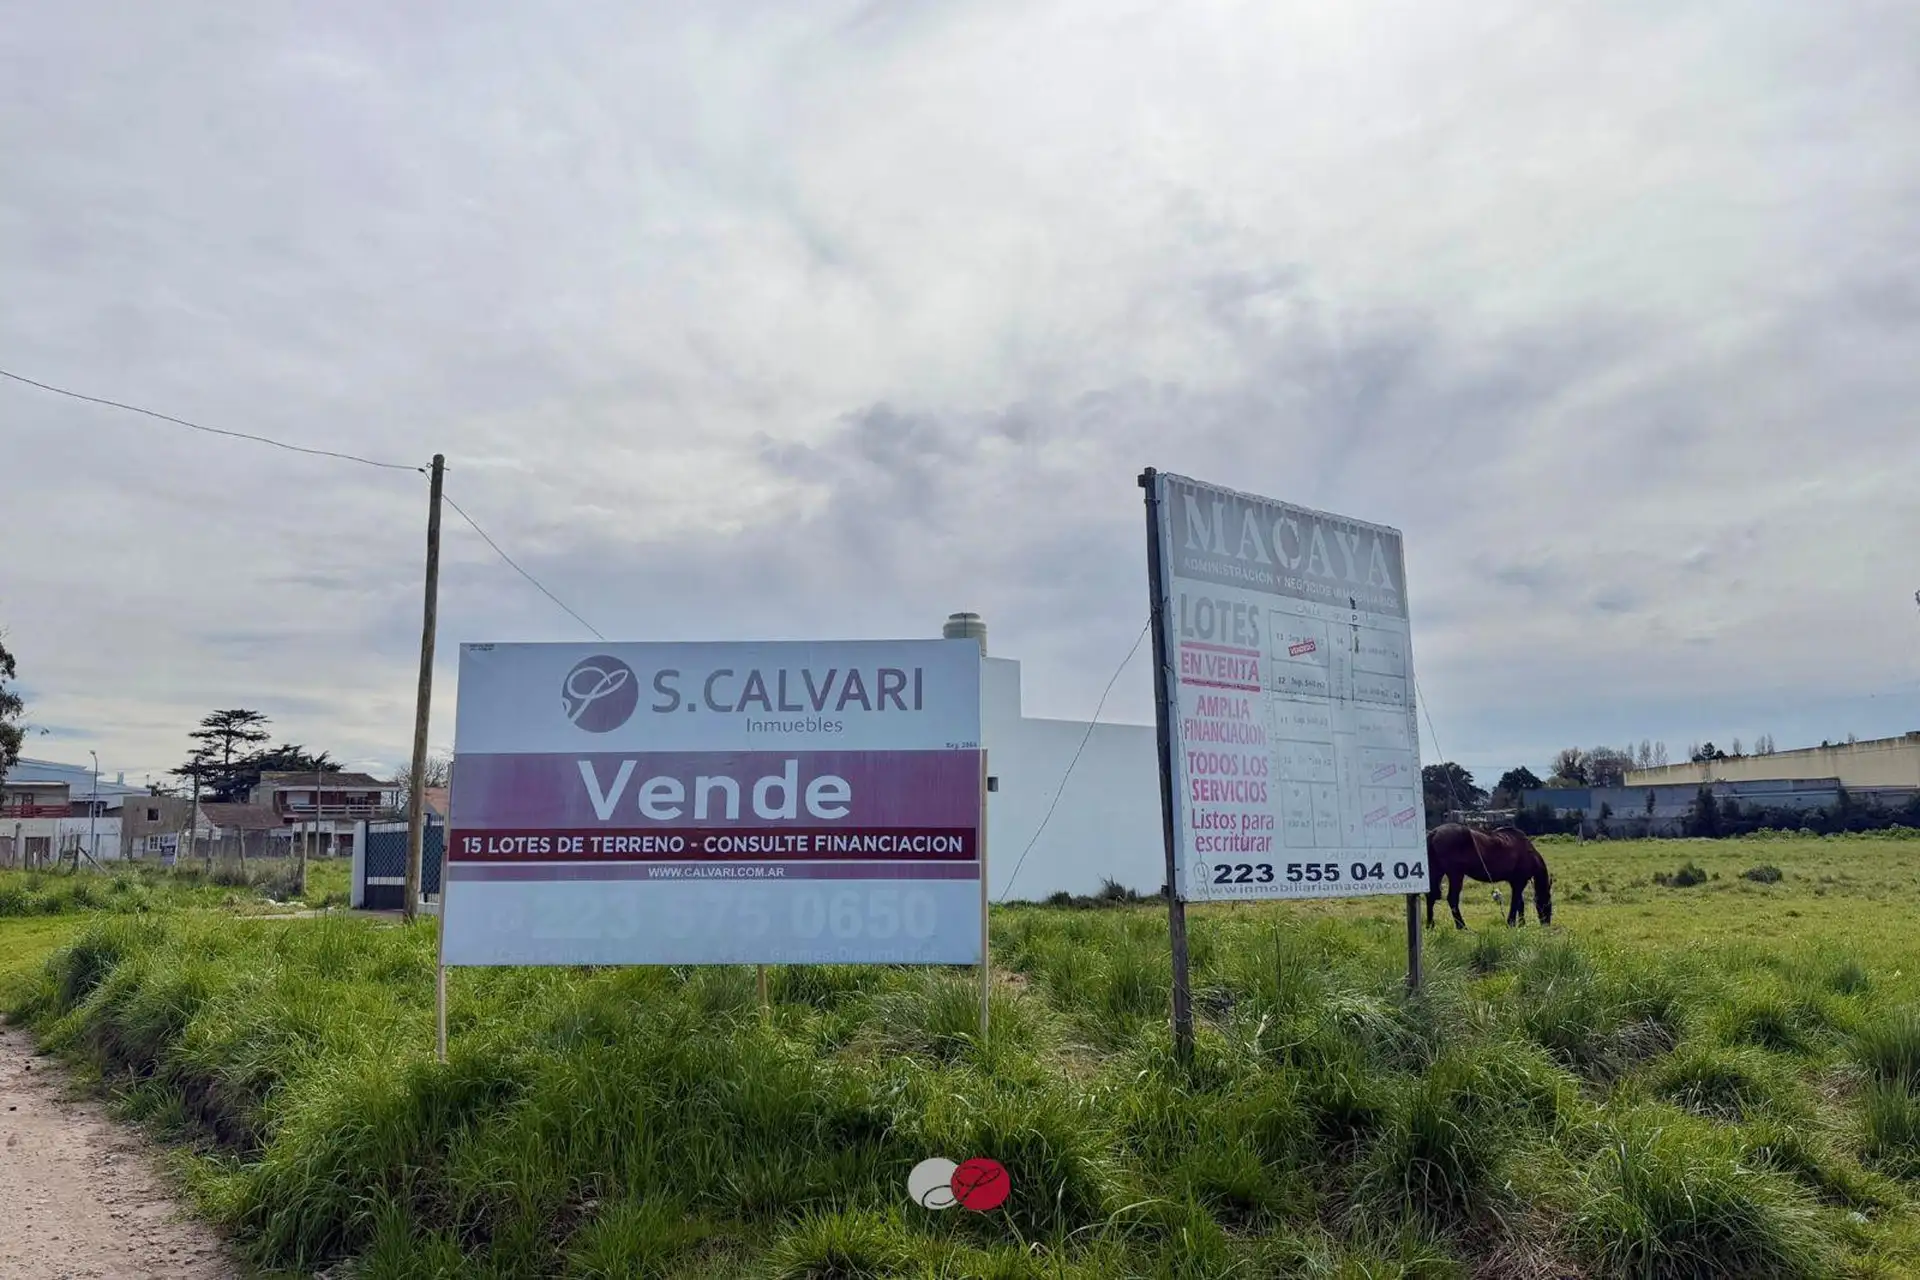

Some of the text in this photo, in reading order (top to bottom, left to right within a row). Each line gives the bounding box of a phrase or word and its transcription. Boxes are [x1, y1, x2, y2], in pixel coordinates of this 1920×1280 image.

[1183, 495, 1397, 592] MACAYA
[1180, 593, 1260, 648] LOTES
[1181, 651, 1260, 682] EN VENTA
[652, 667, 923, 713] S.CALVARI
[1196, 694, 1250, 720] AMPLIA
[746, 716, 844, 733] Inmuebles
[1187, 751, 1239, 776] TODOS
[1243, 754, 1269, 777] LOS
[577, 759, 852, 821] Vende
[1192, 778, 1268, 803] SERVICIOS
[1192, 808, 1237, 830] Listos
[1241, 813, 1275, 835] para
[462, 836, 482, 854] 15
[488, 836, 551, 854] LOTES
[557, 836, 584, 854] DE
[590, 836, 685, 854] TERRENO
[703, 835, 809, 853] CONSULTE
[814, 835, 963, 853] FINANCIACION
[1195, 831, 1272, 852] escriturar
[648, 867, 785, 879] WWW.CALVARI.COM.AR
[1213, 861, 1425, 884] 223 555 04 04
[790, 889, 938, 939] 0650
